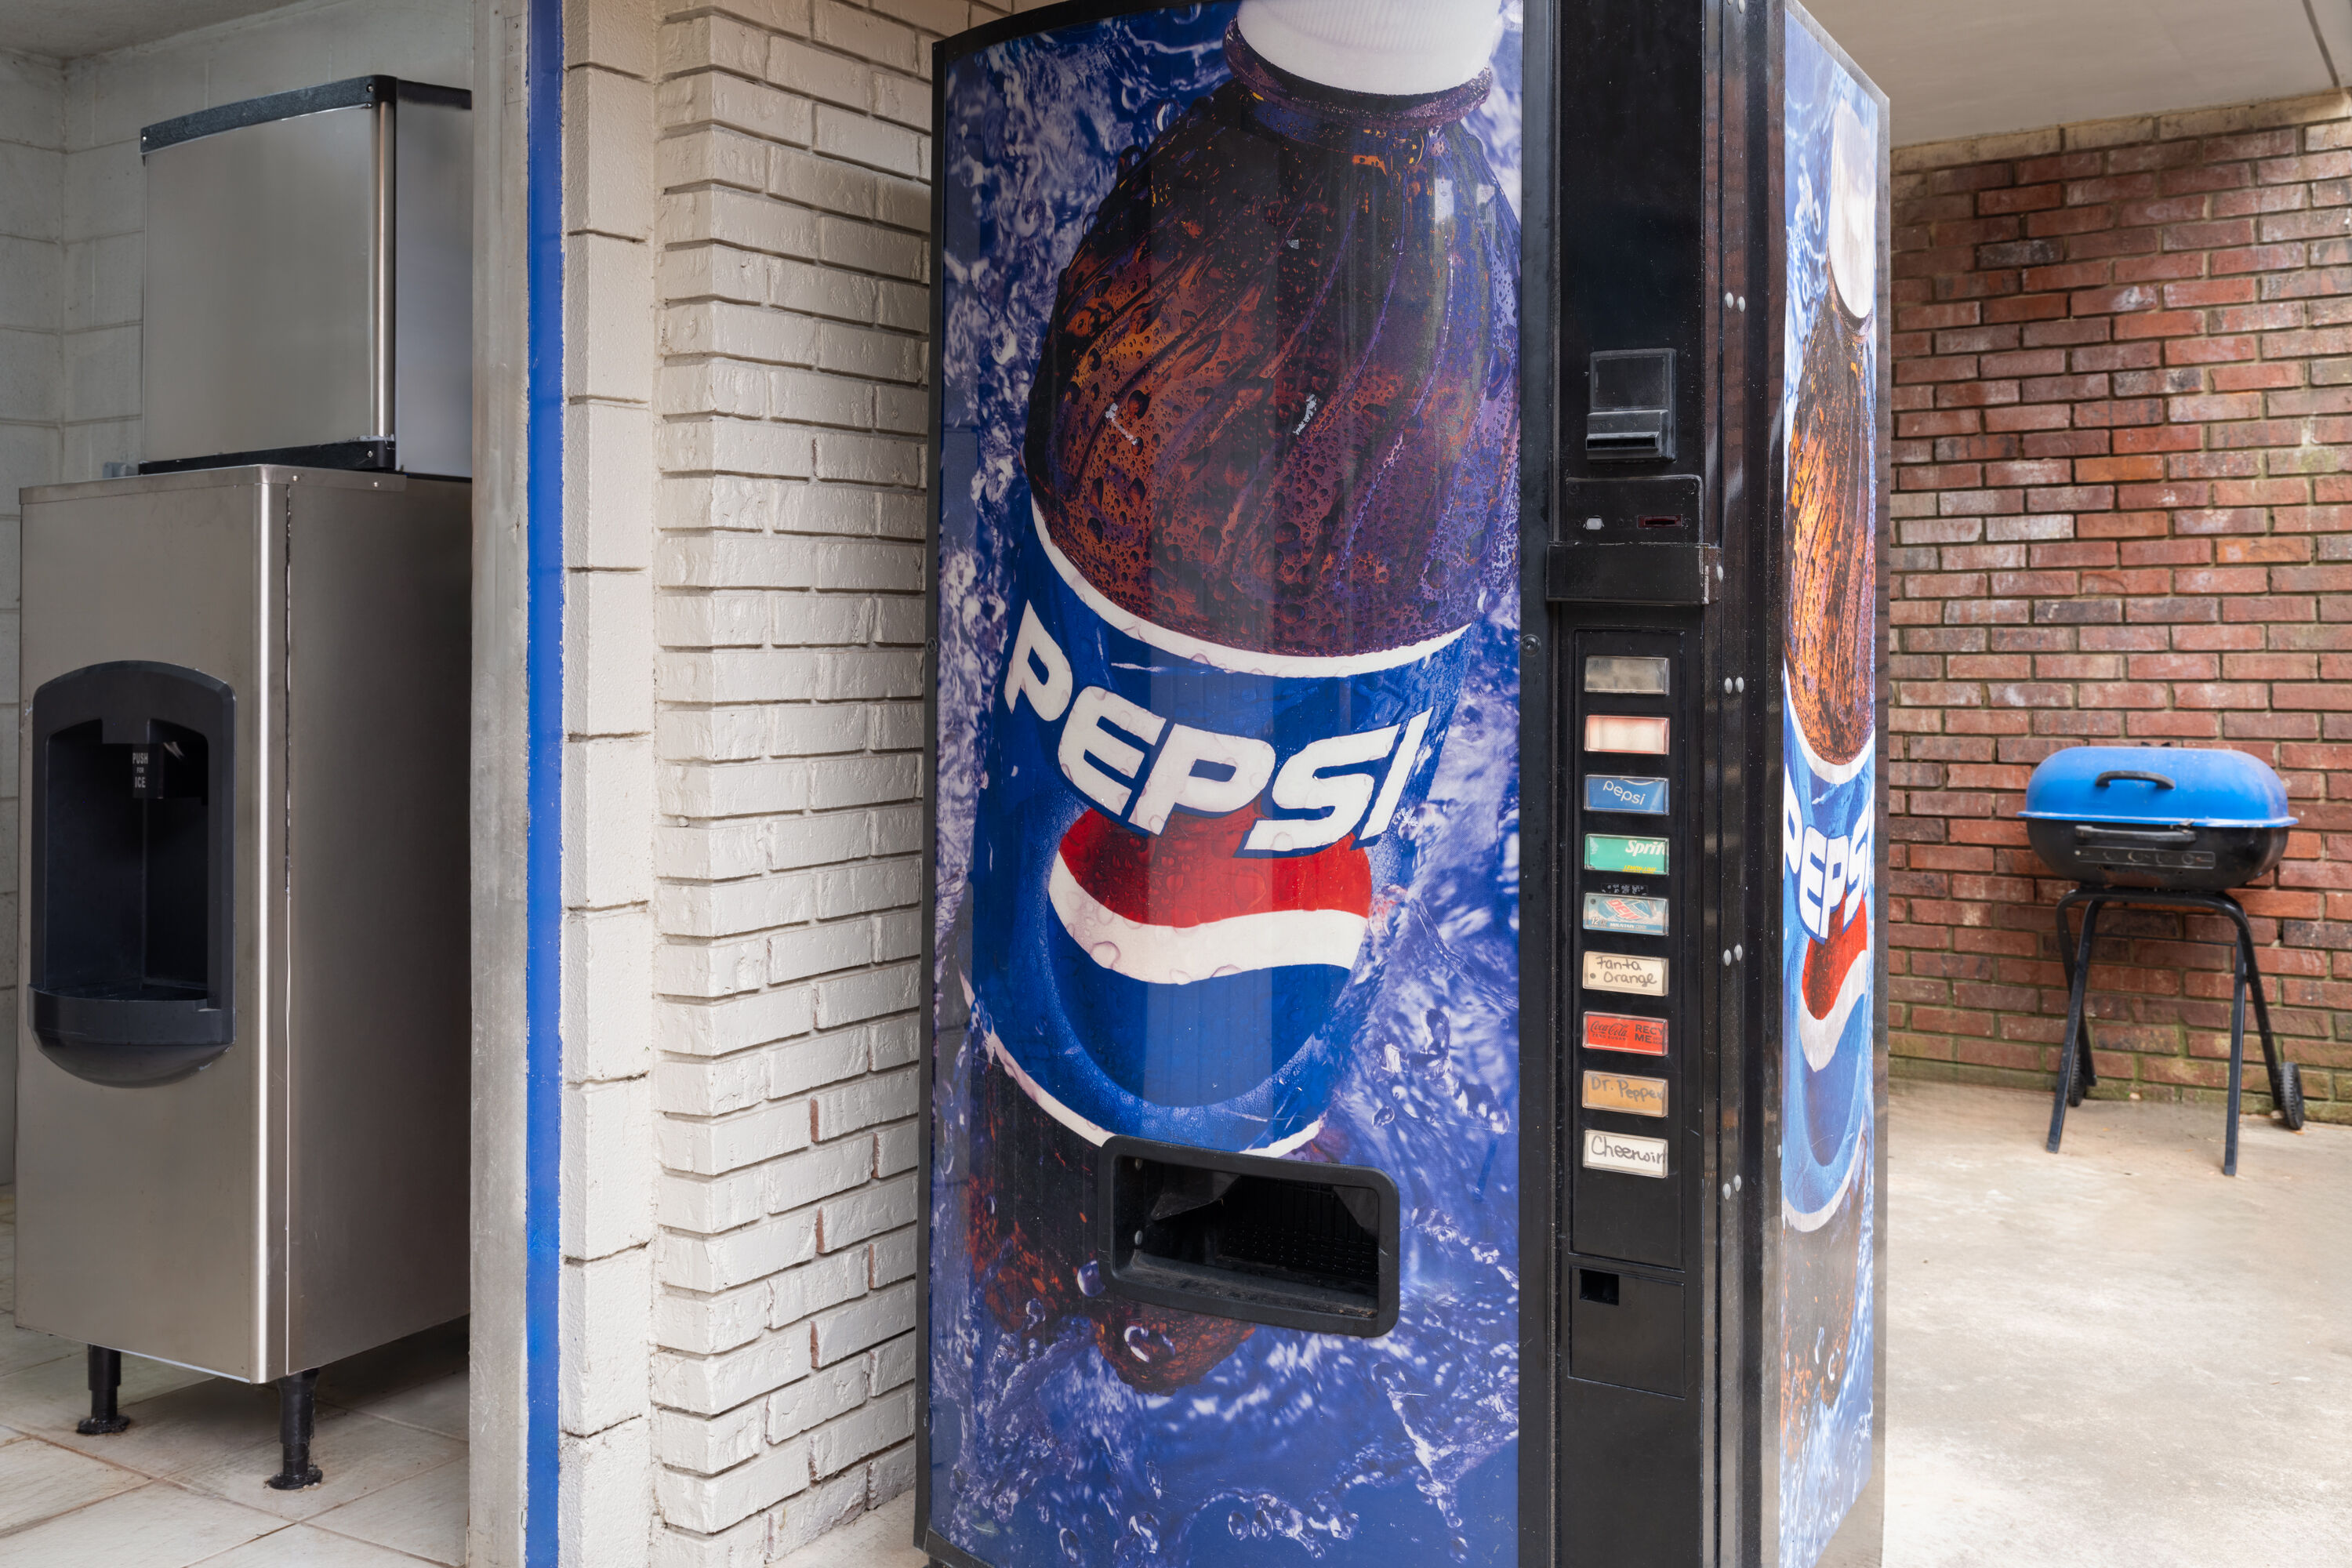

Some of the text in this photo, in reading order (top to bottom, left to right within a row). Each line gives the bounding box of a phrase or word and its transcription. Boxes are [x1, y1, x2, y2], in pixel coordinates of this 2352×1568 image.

[1004, 600, 1434, 853] PEPSI
[132, 753, 149, 764] PUSH
[134, 776, 146, 789] ICE
[1602, 780, 1646, 806] pepsi
[1783, 763, 1875, 939] PEPSI
[1595, 956, 1642, 971] Fanta
[1603, 971, 1657, 988] Orange
[1590, 1021, 1629, 1037] Coca-Cola
[1635, 1033, 1652, 1044] ME
[1591, 1074, 1613, 1091] Dr.
